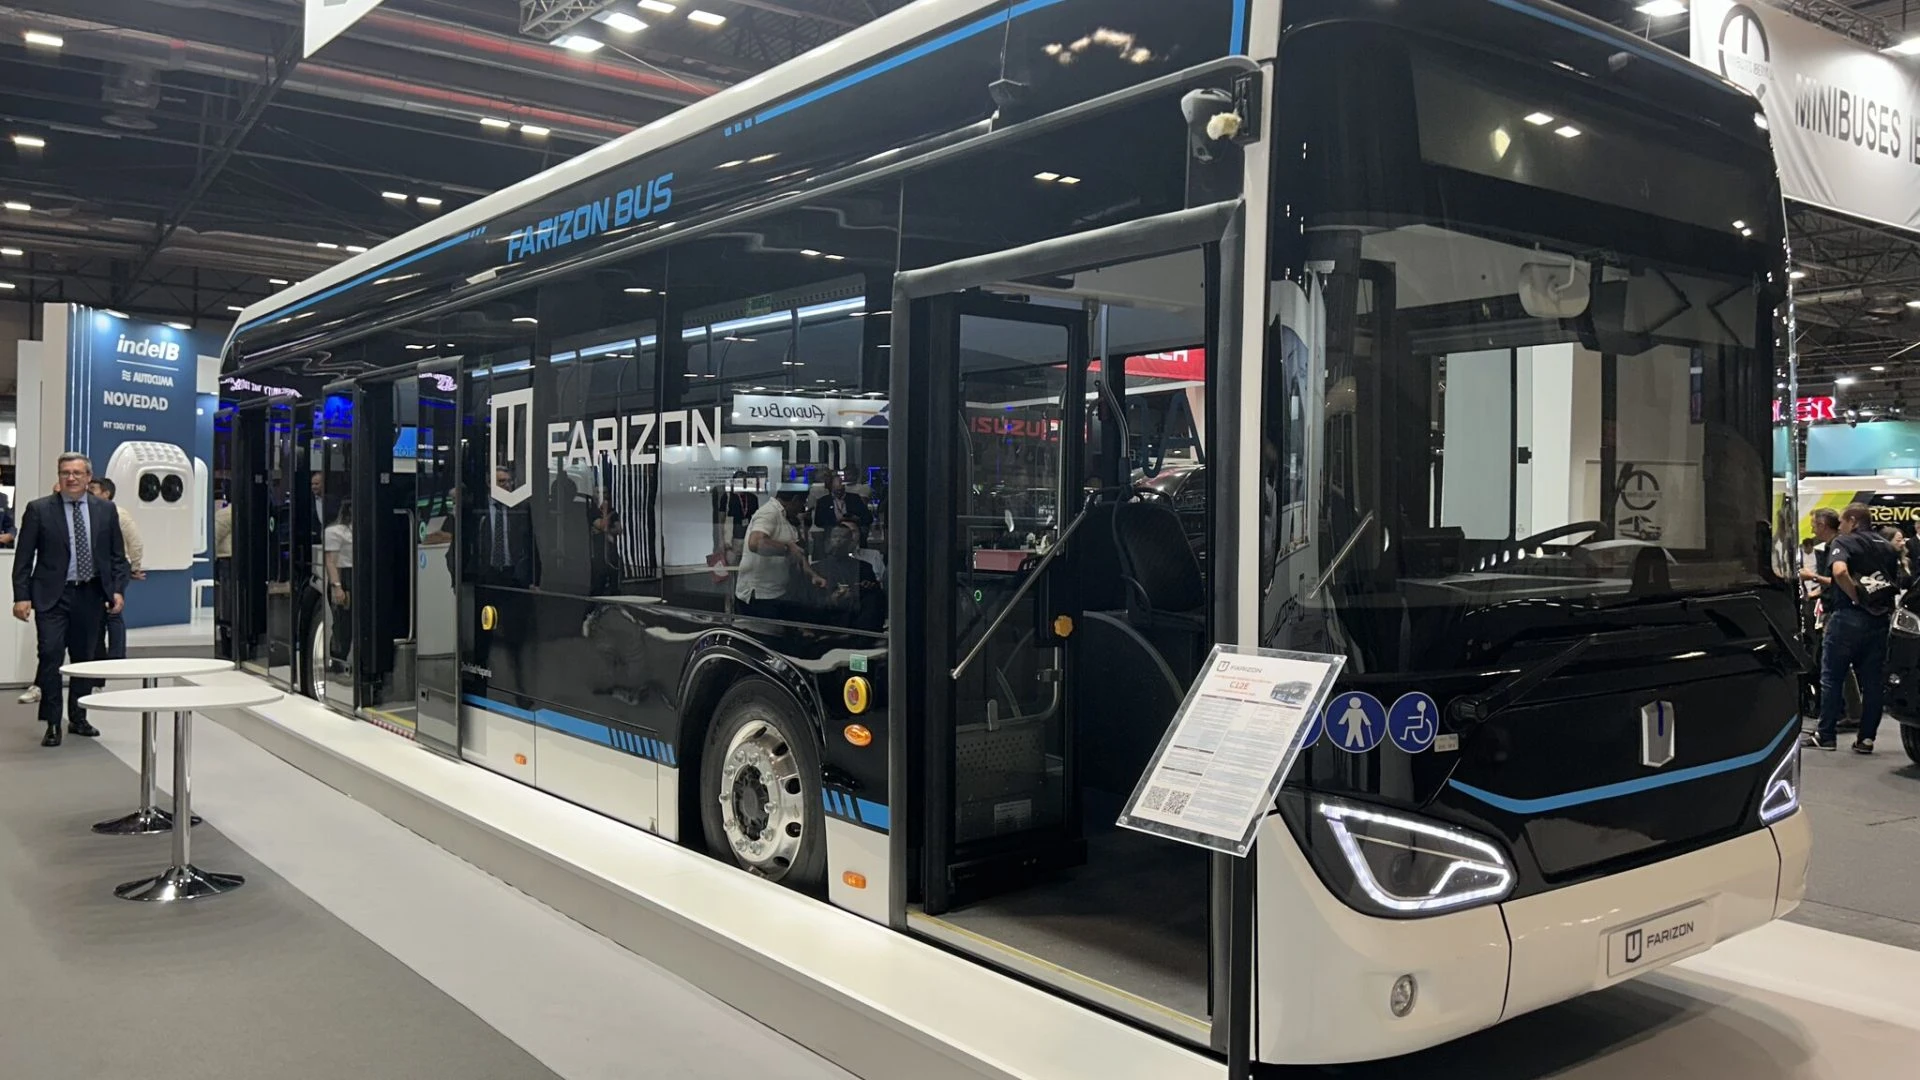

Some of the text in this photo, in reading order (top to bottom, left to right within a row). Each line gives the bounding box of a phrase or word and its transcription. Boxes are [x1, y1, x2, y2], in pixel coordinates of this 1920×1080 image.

[1795, 78, 1901, 158] MINIBUSES
[508, 172, 674, 262] FARIZON BUS
[103, 390, 169, 411] NOVEDAD
[547, 406, 722, 468] FARIZON
[970, 415, 1041, 437] ISUZU
[1647, 921, 1694, 948] FARIZON
